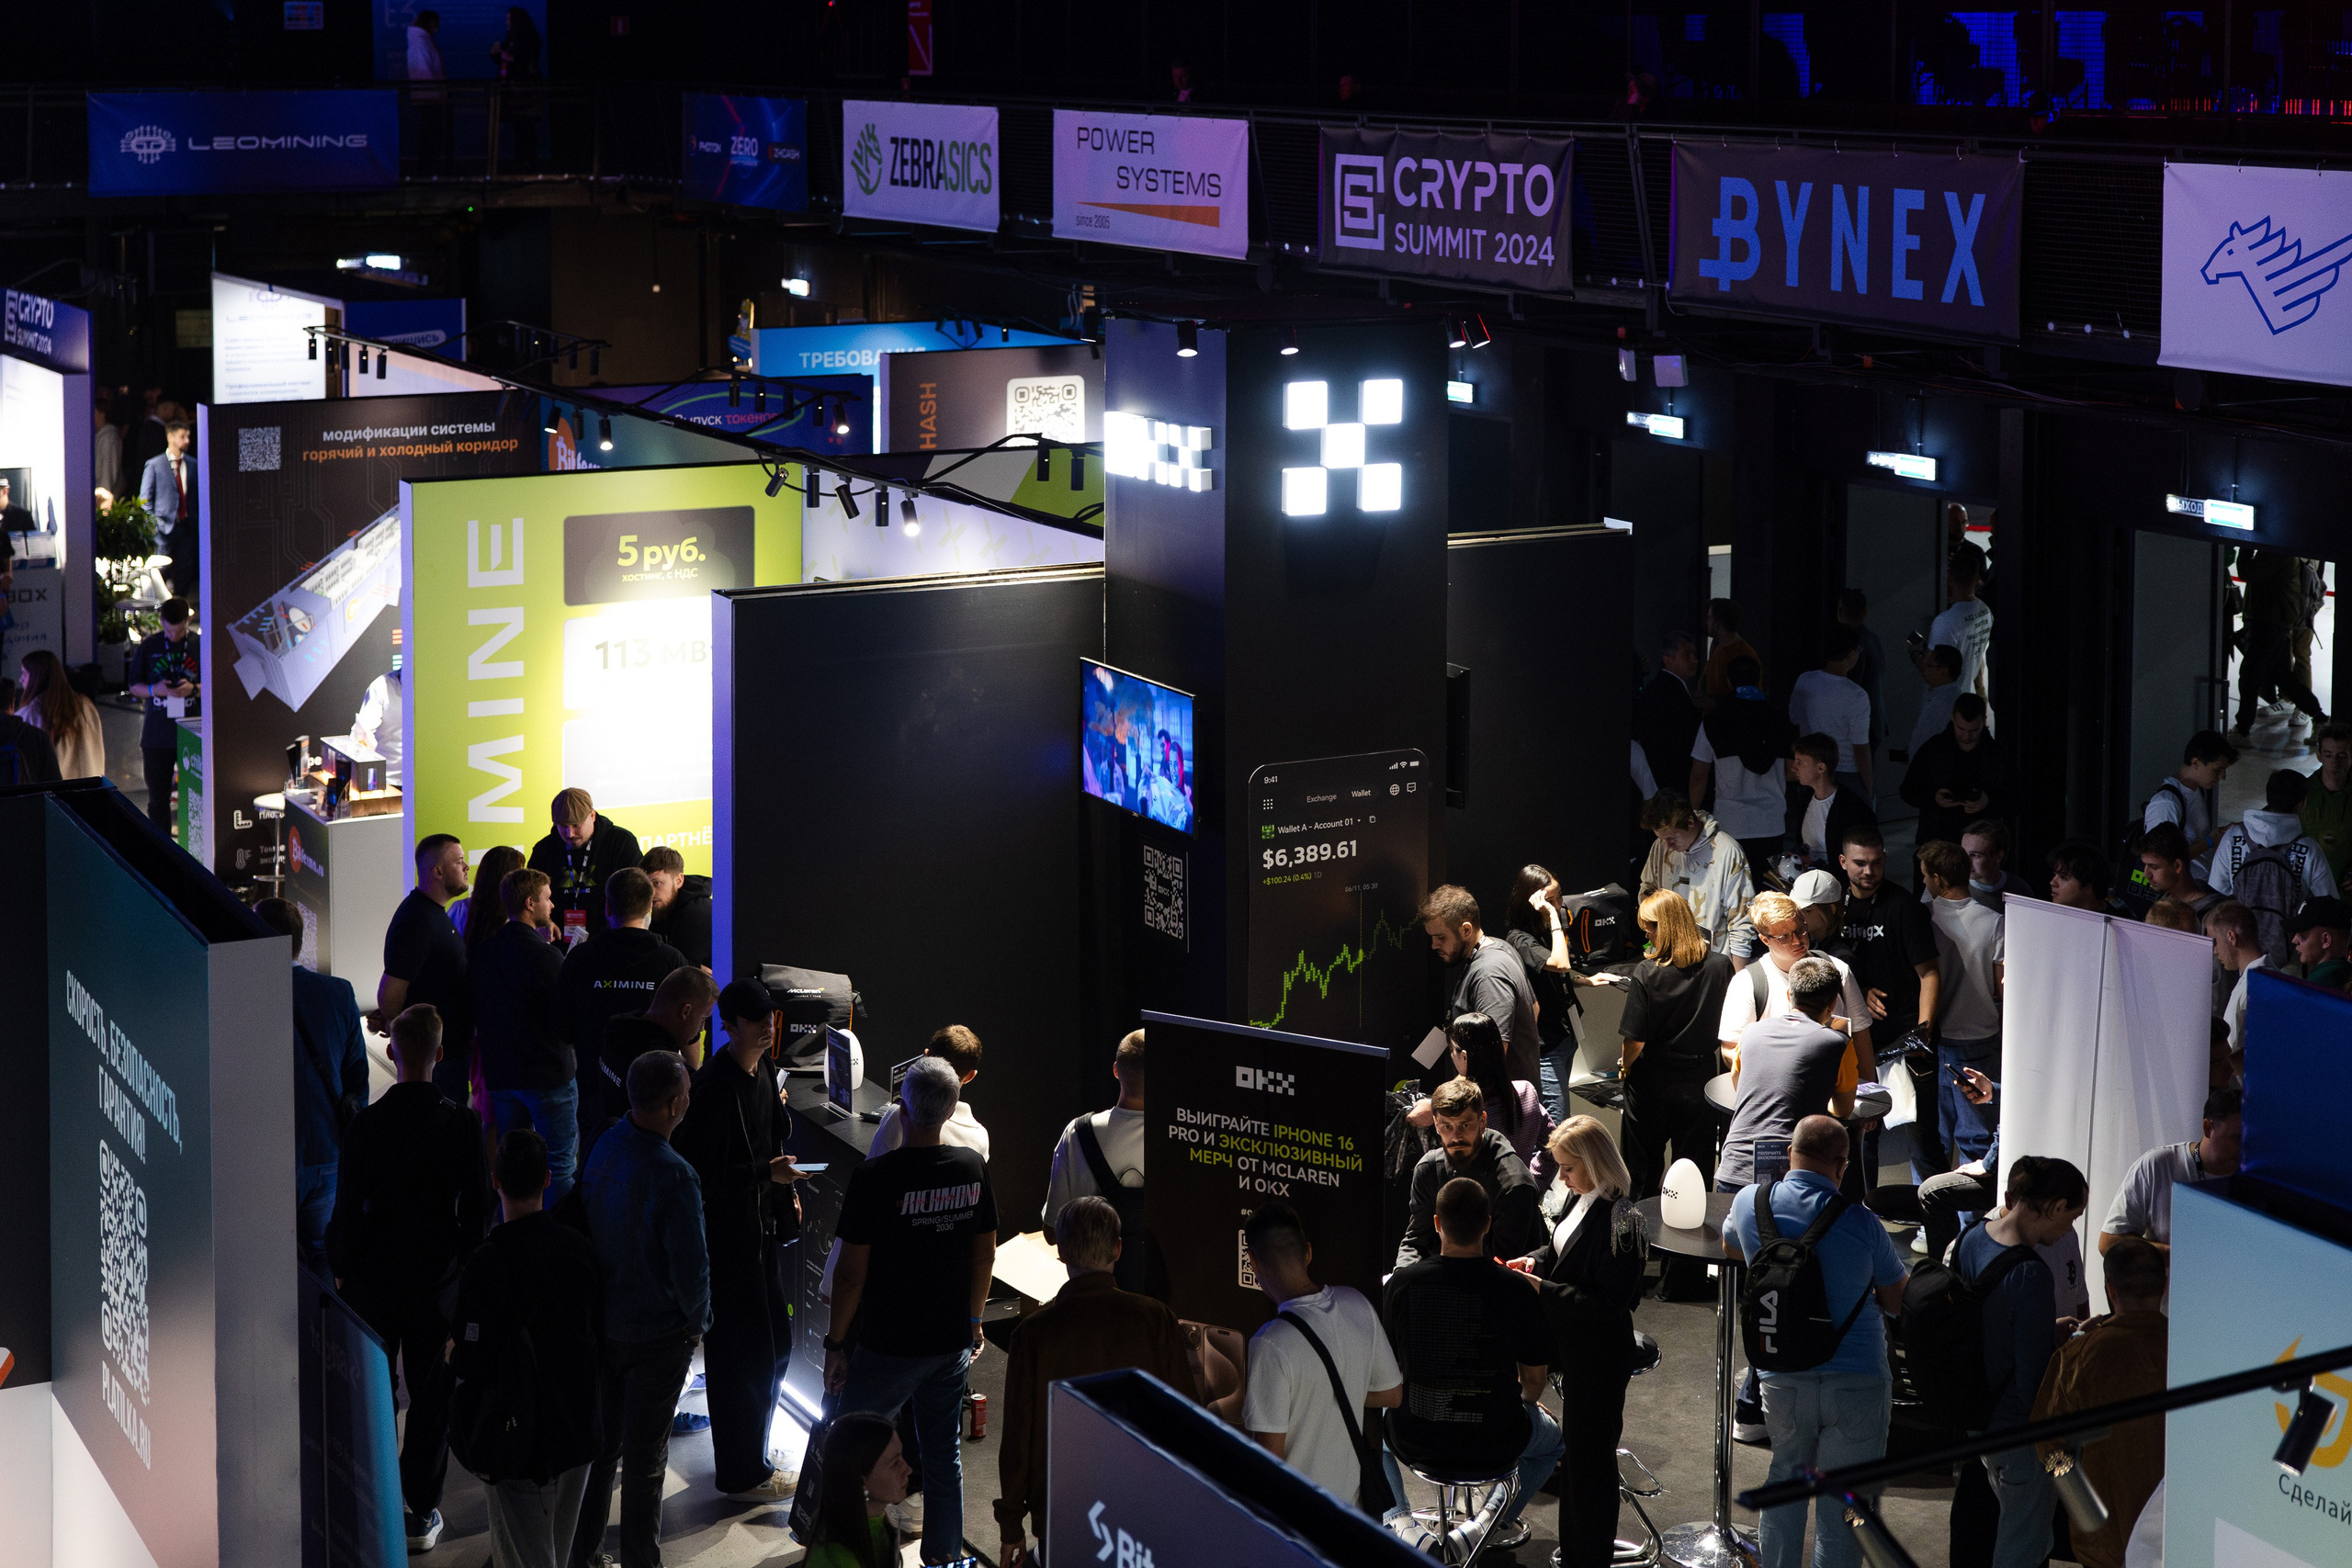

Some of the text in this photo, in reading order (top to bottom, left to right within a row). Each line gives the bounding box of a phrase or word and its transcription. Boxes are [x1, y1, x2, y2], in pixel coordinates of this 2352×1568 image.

[187, 134, 368, 151] LEOMINING
[730, 135, 759, 157] ZERO
[1077, 126, 1156, 155] POWER
[889, 137, 992, 195] ZEBRASICS
[1116, 165, 1222, 198] SYSTEMS
[1393, 156, 1555, 217] CRYPTO
[1076, 214, 1111, 230] since 2005
[1394, 222, 1555, 267] SUMMIT 2024
[18, 292, 55, 330] CRYPTO
[920, 382, 937, 449] HASH
[322, 422, 495, 442] модификации системы
[302, 438, 518, 463] горячий и холодный коридор
[2169, 497, 2204, 513] ЫХОД
[617, 535, 707, 571] 5 руб.
[622, 571, 665, 583] хостинг,
[674, 568, 698, 581] НДС
[595, 638, 713, 670] 113 МВ
[1263, 775, 1278, 784] 9:41
[1306, 788, 1372, 804] Exchange Wallet
[1278, 825, 1300, 834] Wallet
[1314, 819, 1343, 829] Account
[1345, 818, 1353, 826] 01
[1262, 840, 1357, 869] $6,389.61
[1262, 871, 1323, 886] +$100.24 (0.4%) 1D
[1363, 883, 1378, 891] 05:30
[1594, 916, 1616, 927] OKX
[594, 980, 655, 990] AXIMINE
[790, 1023, 817, 1033] OKX
[66, 969, 183, 1155] СКОРОСТЬ, БЕЗОПАСНОСТЬ,
[1236, 1066, 1295, 1096] OKX
[98, 1065, 146, 1165] ГАРАНТИЯ!
[1177, 1107, 1354, 1151] ВЫИГРАЙТЕ IPHONE 16
[1169, 1125, 1363, 1172] PRO И ЭКСКЛЮЗИВНЫЙ
[1190, 1147, 1340, 1187] МЕРЧ ОТ MCLAREN
[900, 1181, 981, 1215] RICHMOND
[1239, 1175, 1290, 1198] И OKX
[912, 1211, 974, 1226] SPRING/SUMMER
[936, 1223, 955, 1232] 2030
[1758, 1290, 1778, 1355] FILA
[102, 1360, 151, 1470] PLATILKA.RU
[2278, 1473, 2351, 1526] Сделай
